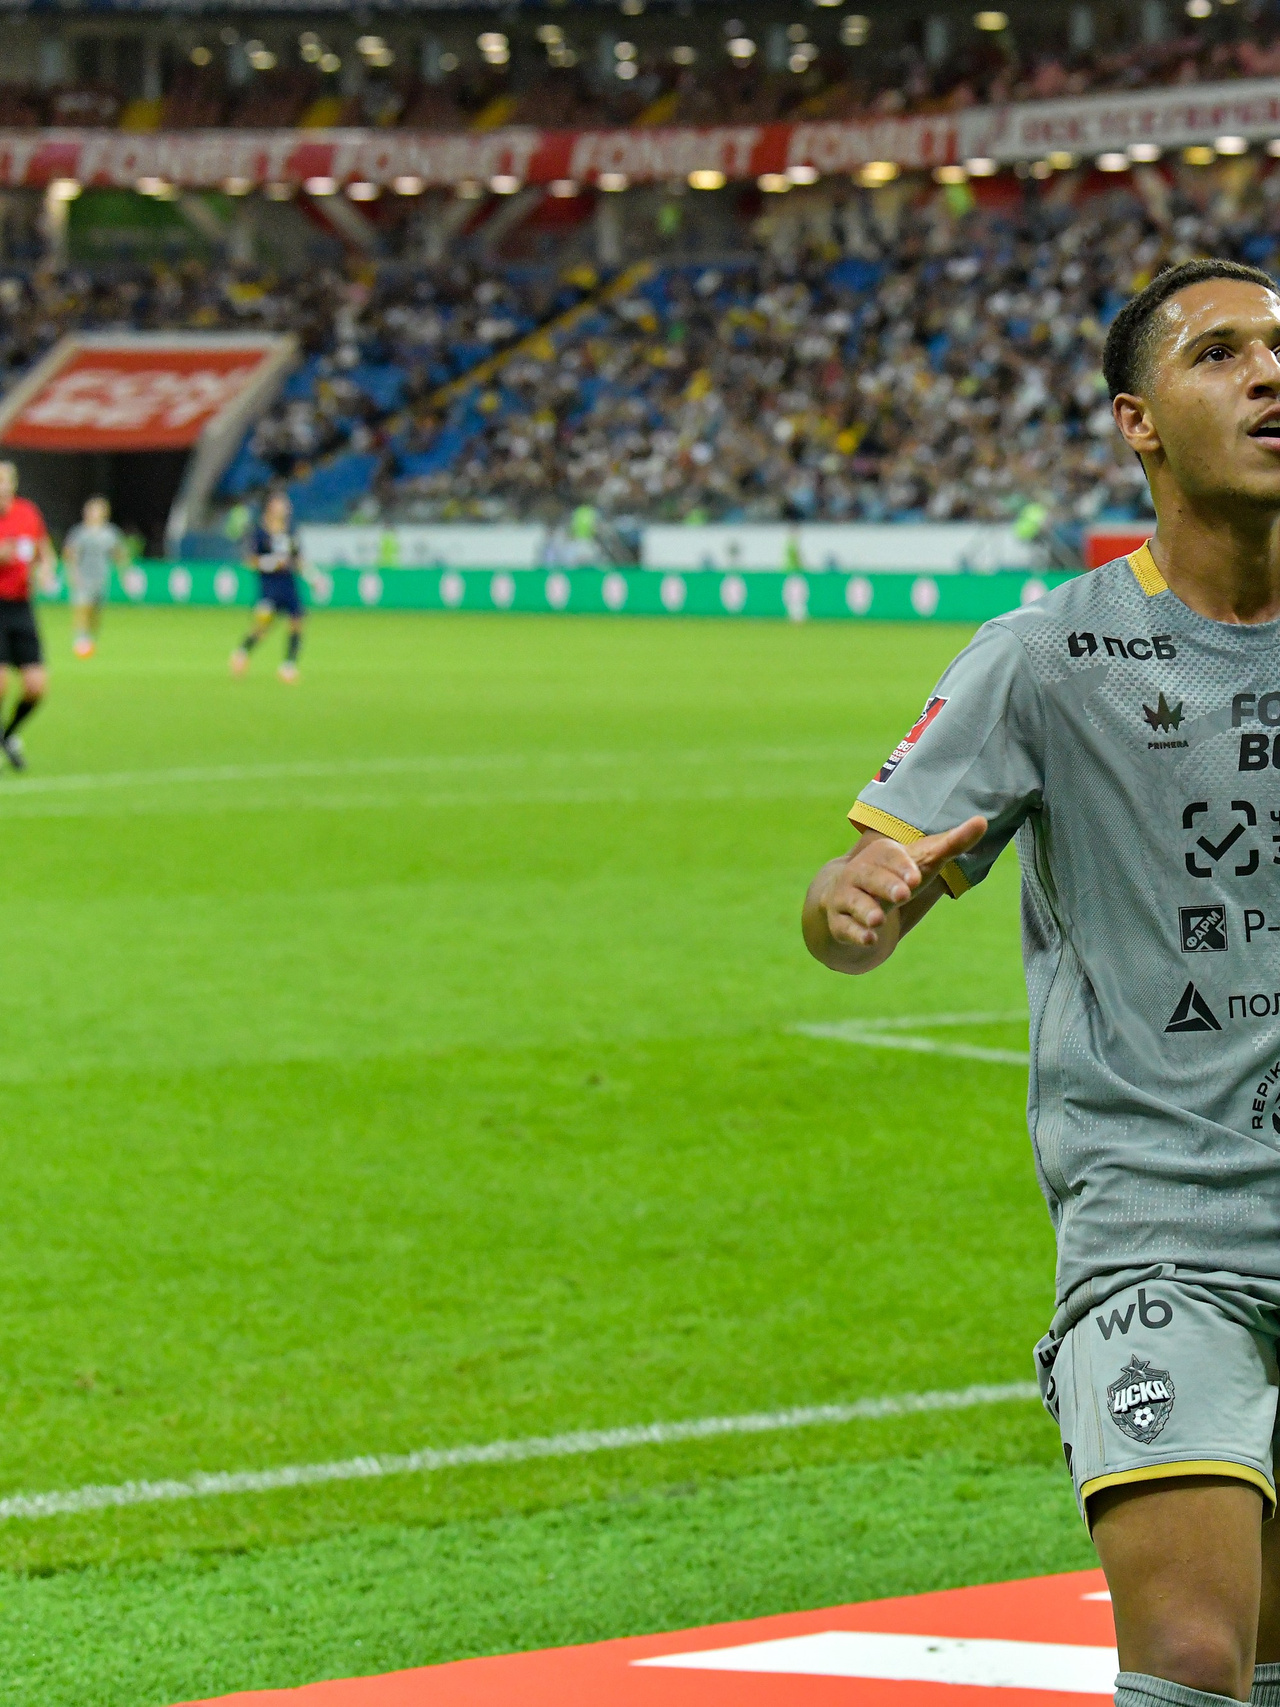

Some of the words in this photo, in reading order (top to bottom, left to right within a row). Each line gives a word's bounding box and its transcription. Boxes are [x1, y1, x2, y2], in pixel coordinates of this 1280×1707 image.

[1102, 634, 1177, 661] ПСБ
[1147, 740, 1189, 750] PRIMERA
[1186, 910, 1221, 948] ФАРМ
[1096, 1288, 1173, 1341] wb
[1112, 1379, 1171, 1414] ЦСКА
